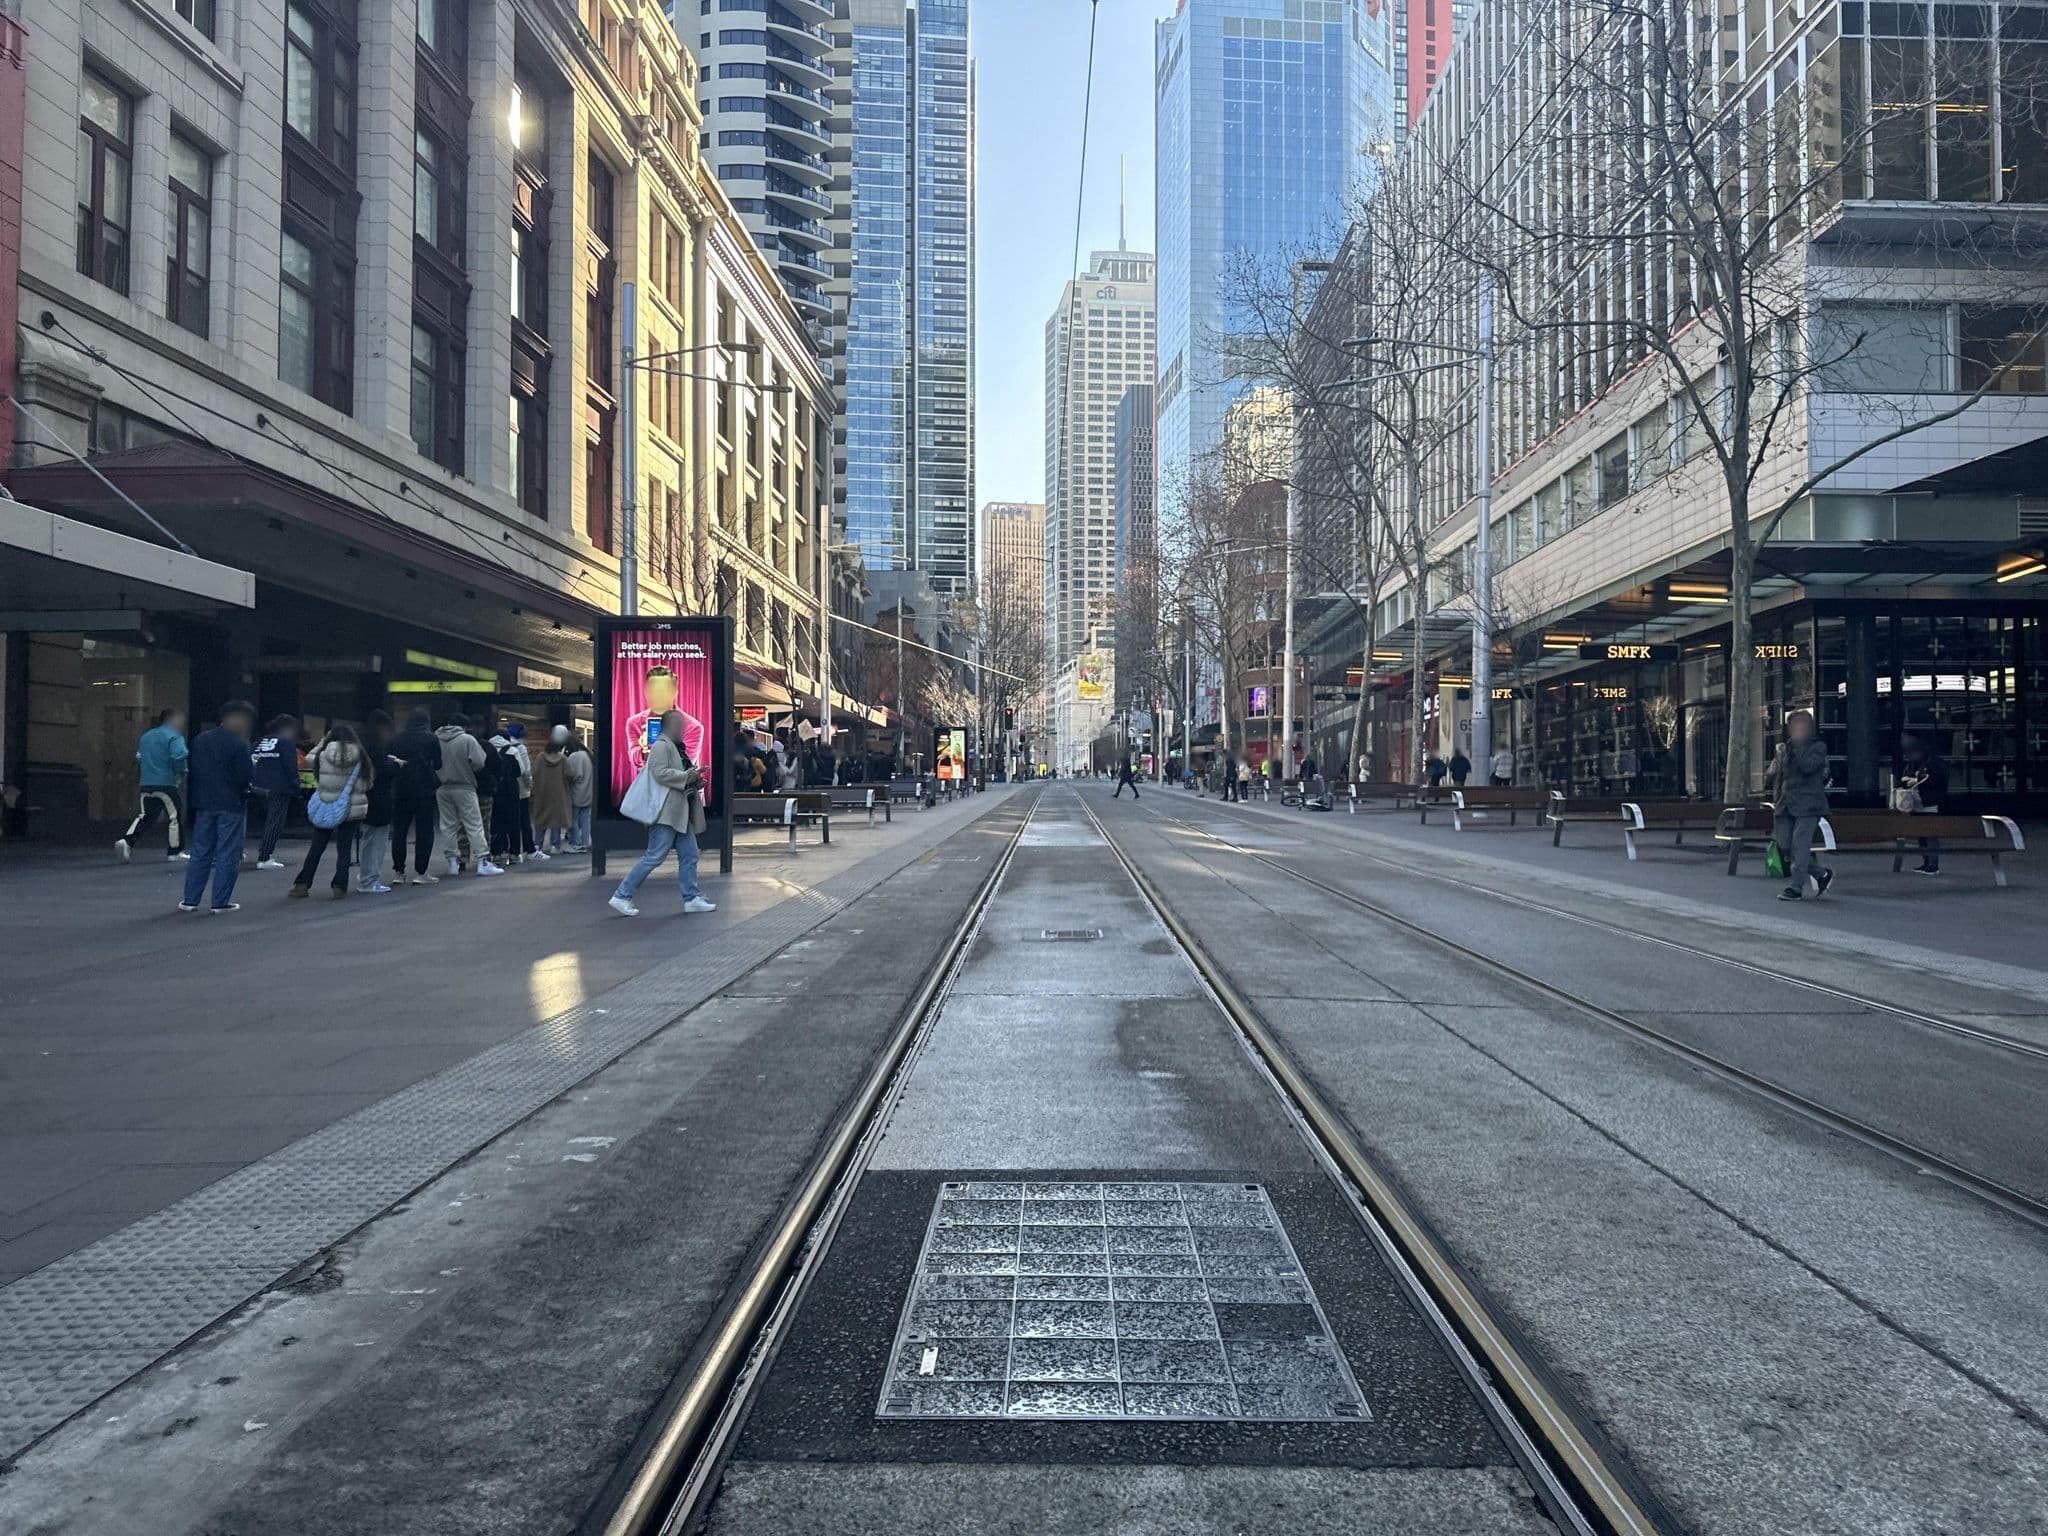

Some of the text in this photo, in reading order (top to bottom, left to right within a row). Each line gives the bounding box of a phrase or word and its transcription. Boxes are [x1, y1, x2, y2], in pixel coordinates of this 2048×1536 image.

[1097, 286, 1116, 300] citi
[621, 642, 701, 651] Better job matches,
[1607, 645, 1651, 659] SMFK
[642, 651, 667, 660] salary
[668, 652, 684, 660] you
